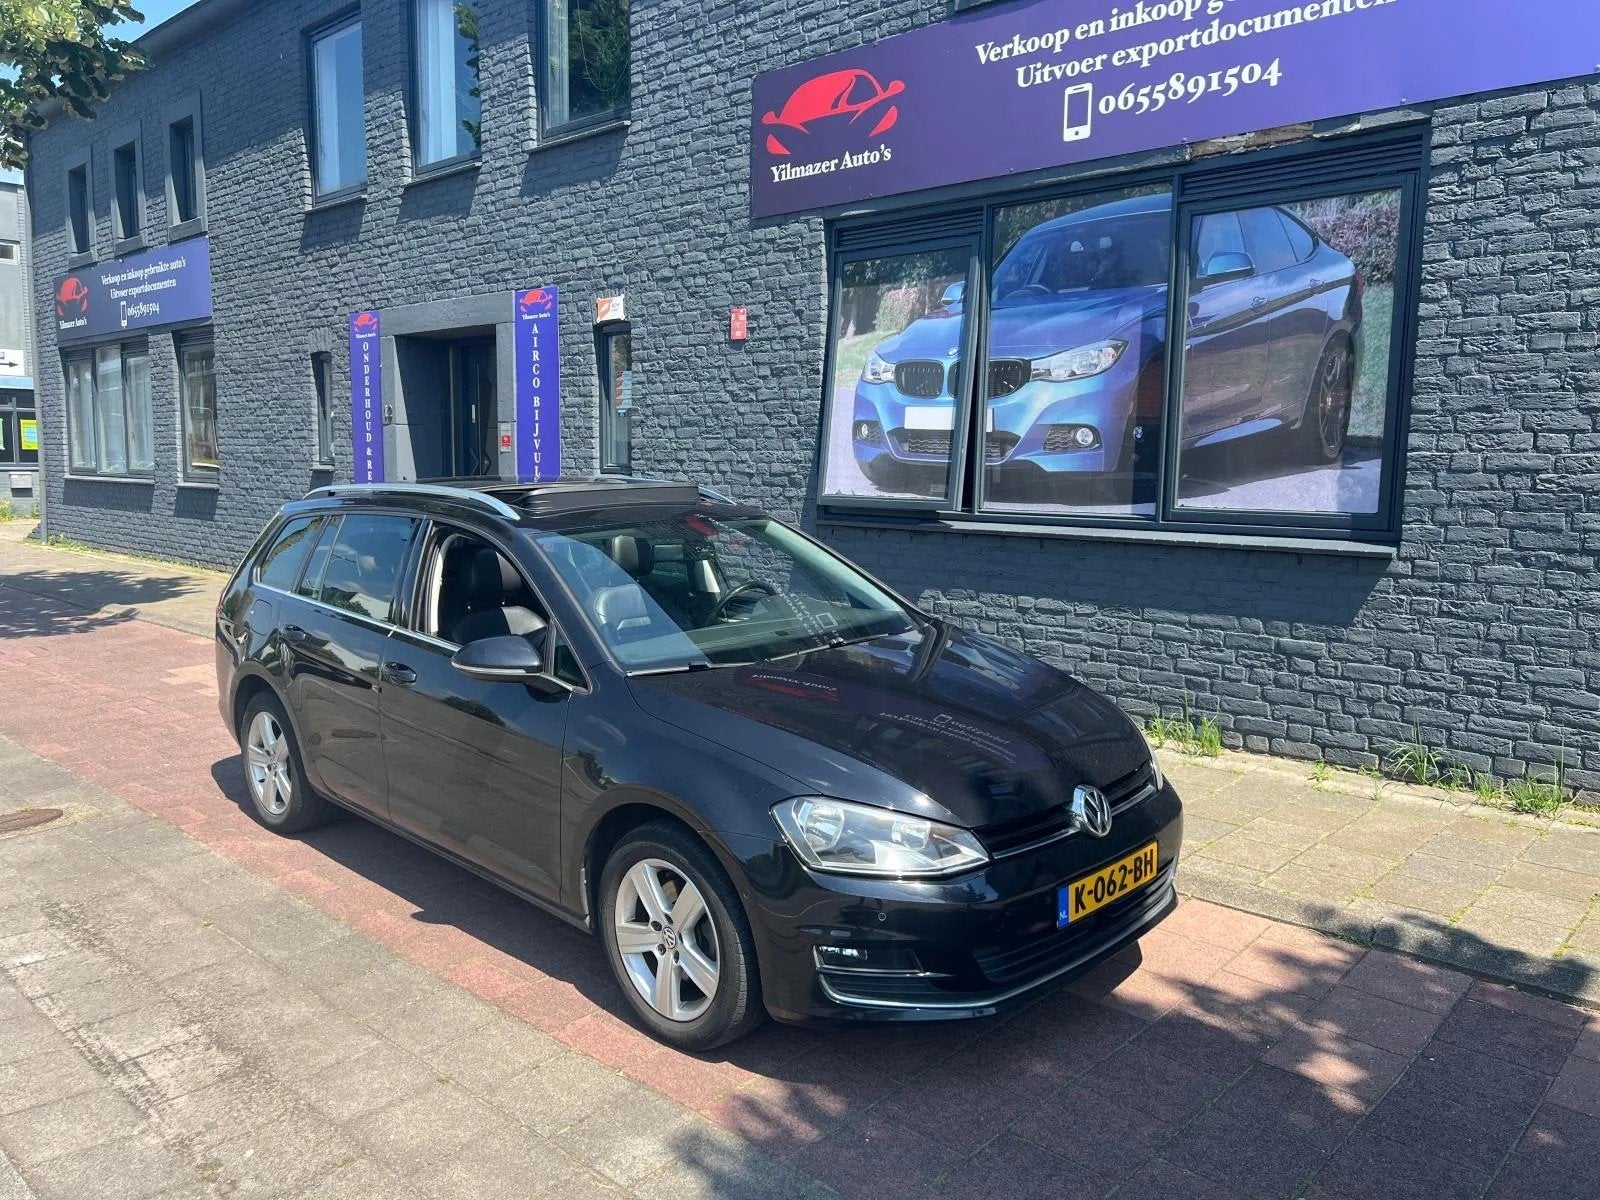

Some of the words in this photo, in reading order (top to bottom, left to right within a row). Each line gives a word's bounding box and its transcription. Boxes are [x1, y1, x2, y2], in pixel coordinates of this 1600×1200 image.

[974, 27, 1070, 64] Verkoop
[1074, 19, 1105, 40] en
[1109, 0, 1200, 32] inkoop
[1015, 53, 1108, 88] Uitvoer
[1098, 57, 1283, 115] 0655891504
[770, 158, 839, 183] Yilmazer
[839, 143, 892, 170] Auto's
[531, 323, 541, 388] AIRCO
[362, 341, 372, 442] ONDERHOUD
[366, 447, 373, 456] &
[531, 396, 541, 483] BIJVUL
[1074, 848, 1154, 915] K-062-BH
[1059, 910, 1068, 921] NL
